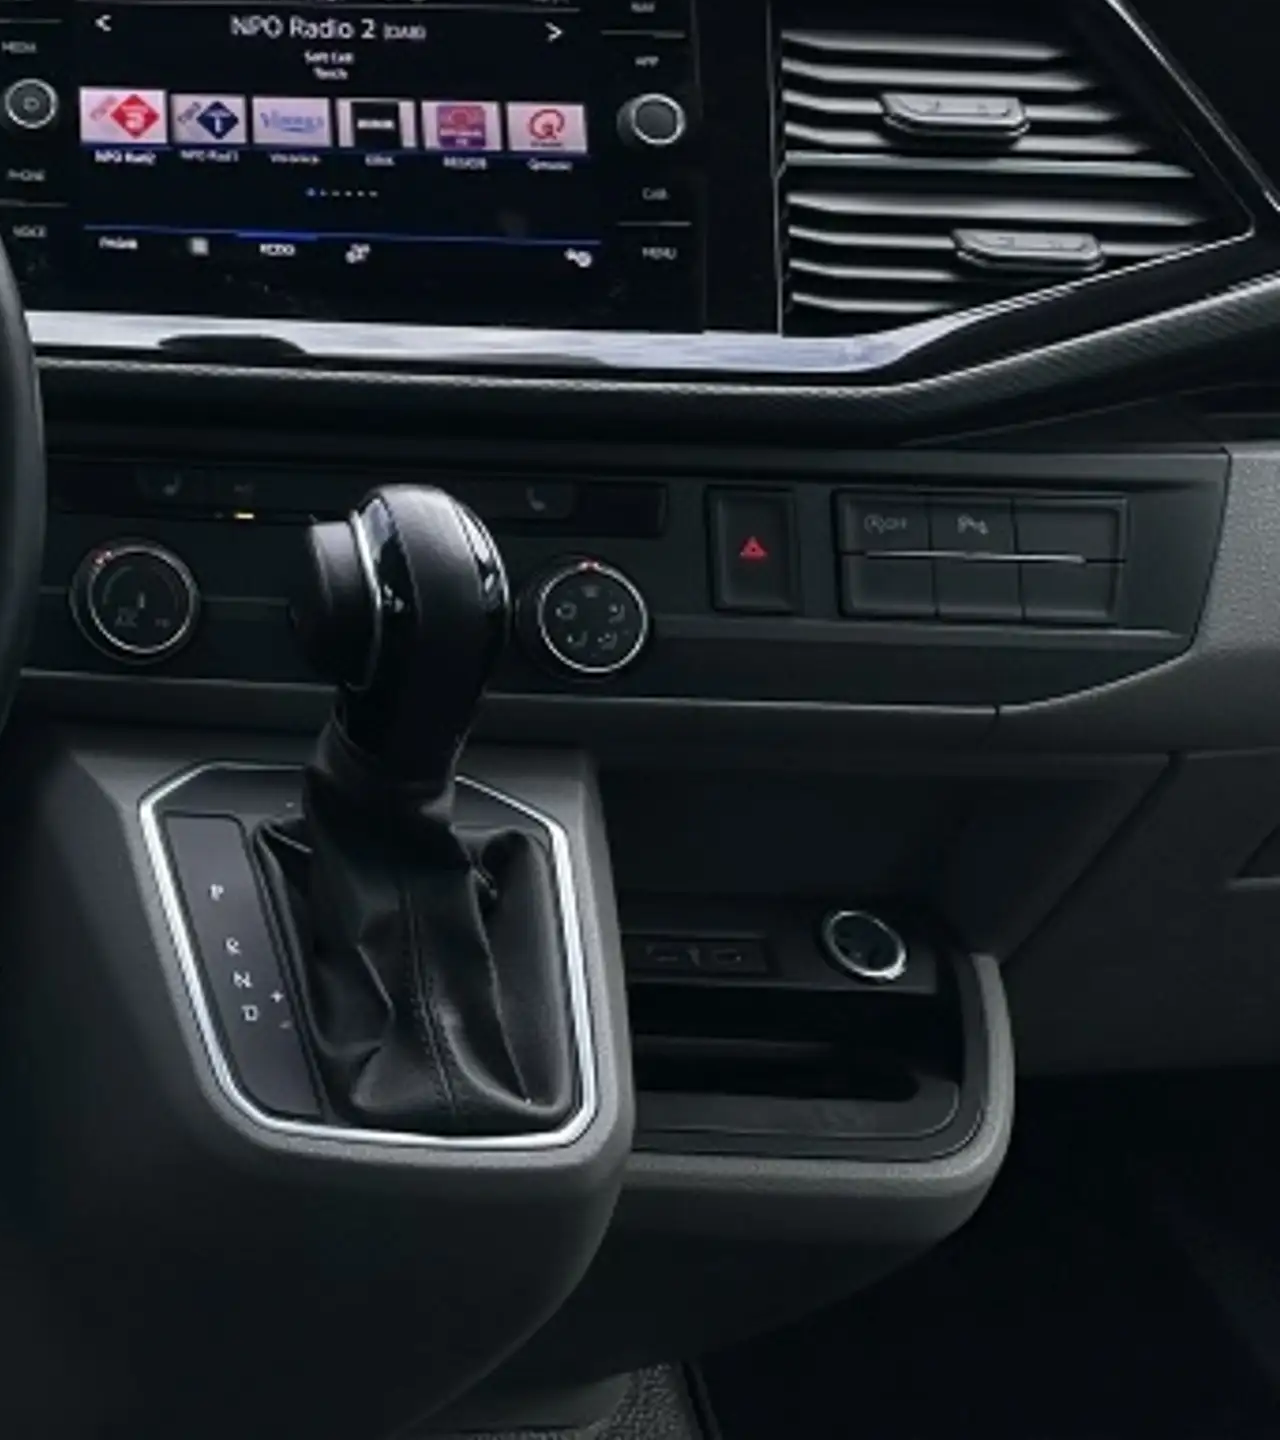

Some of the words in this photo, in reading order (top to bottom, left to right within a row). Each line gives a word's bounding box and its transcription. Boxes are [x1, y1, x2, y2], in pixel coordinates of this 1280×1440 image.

[230, 14, 284, 39] NPO
[290, 14, 356, 39] Radio
[360, 17, 377, 40] 2
[642, 246, 678, 260] MENU
[209, 882, 225, 902] P
[225, 936, 241, 955] R
[232, 970, 253, 989] N
[241, 1003, 258, 1022] D
